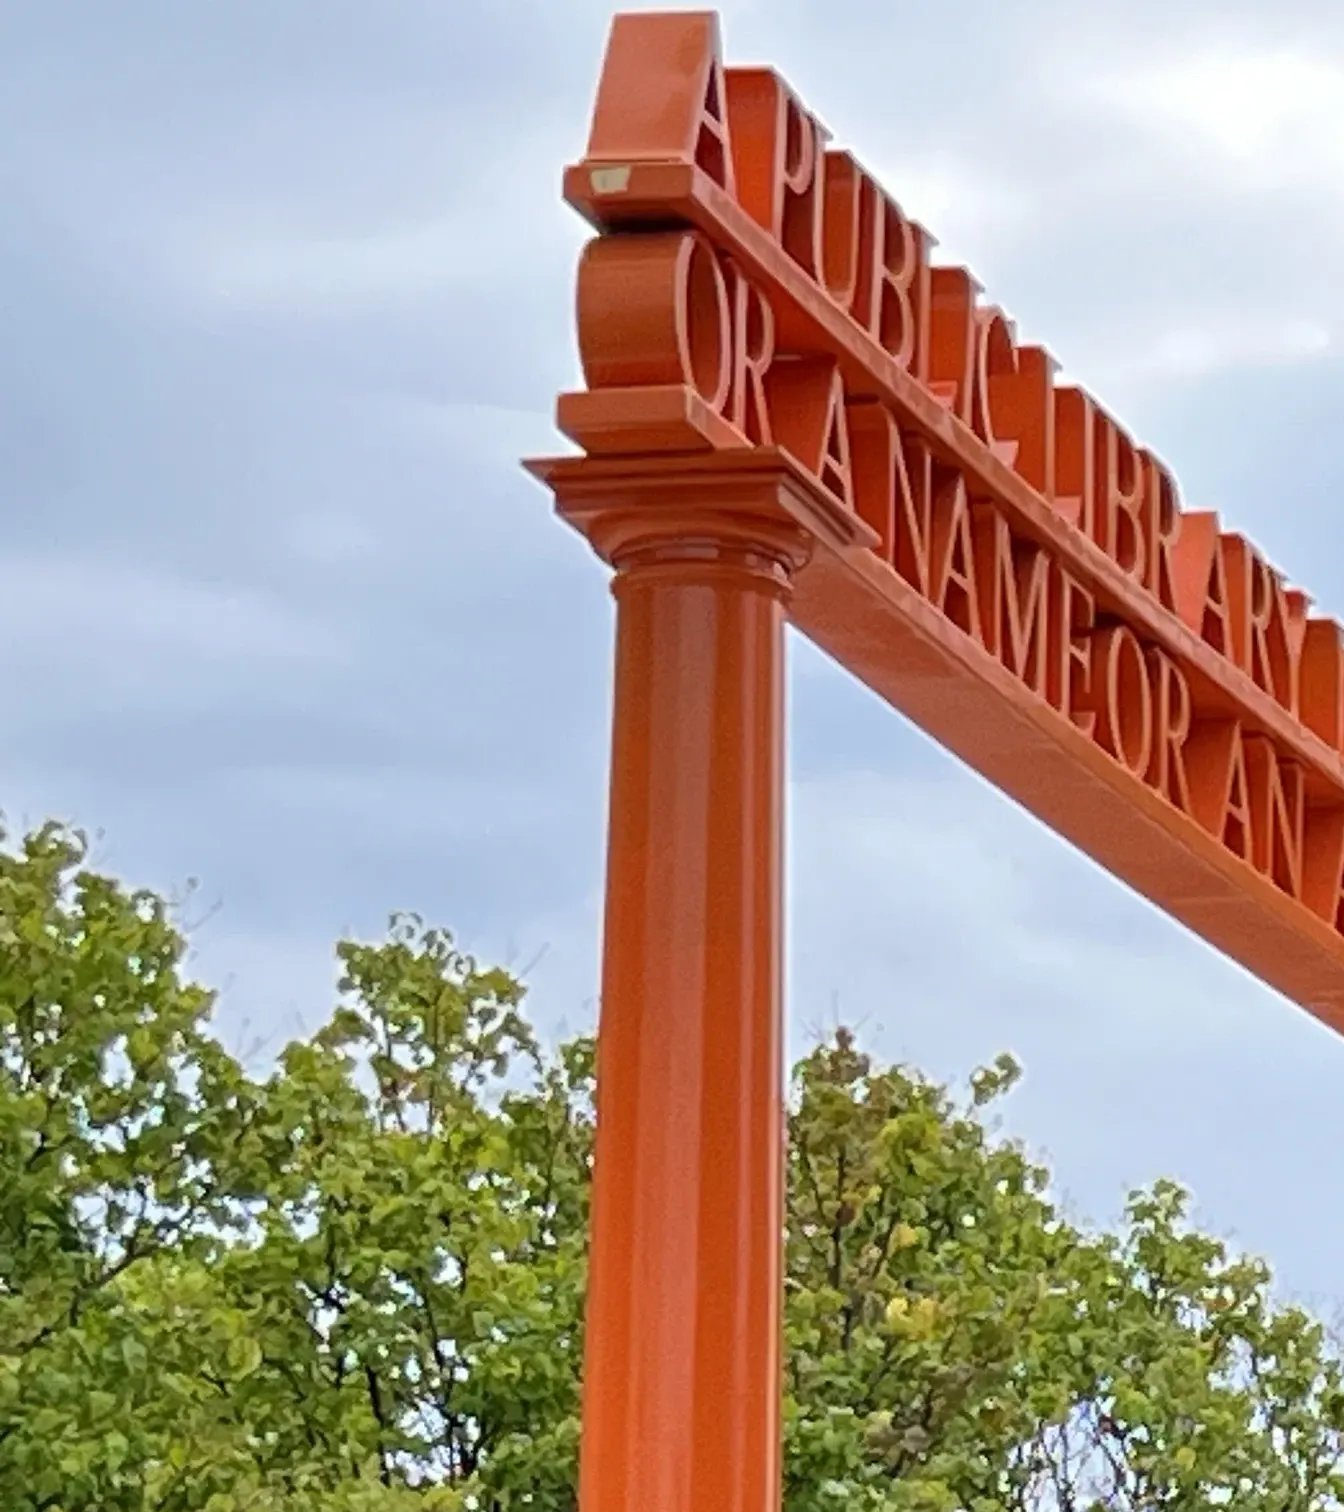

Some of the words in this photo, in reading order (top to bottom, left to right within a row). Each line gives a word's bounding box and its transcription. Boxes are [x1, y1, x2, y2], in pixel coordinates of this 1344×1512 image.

[674, 231, 774, 450] OR
[808, 364, 854, 508] A
[883, 402, 1096, 737] NAME
[1105, 624, 1194, 820] OR
[1217, 717, 1304, 902] AN
[767, 66, 1018, 470] PUBLIC
[1041, 345, 1316, 722] LIBRARY
